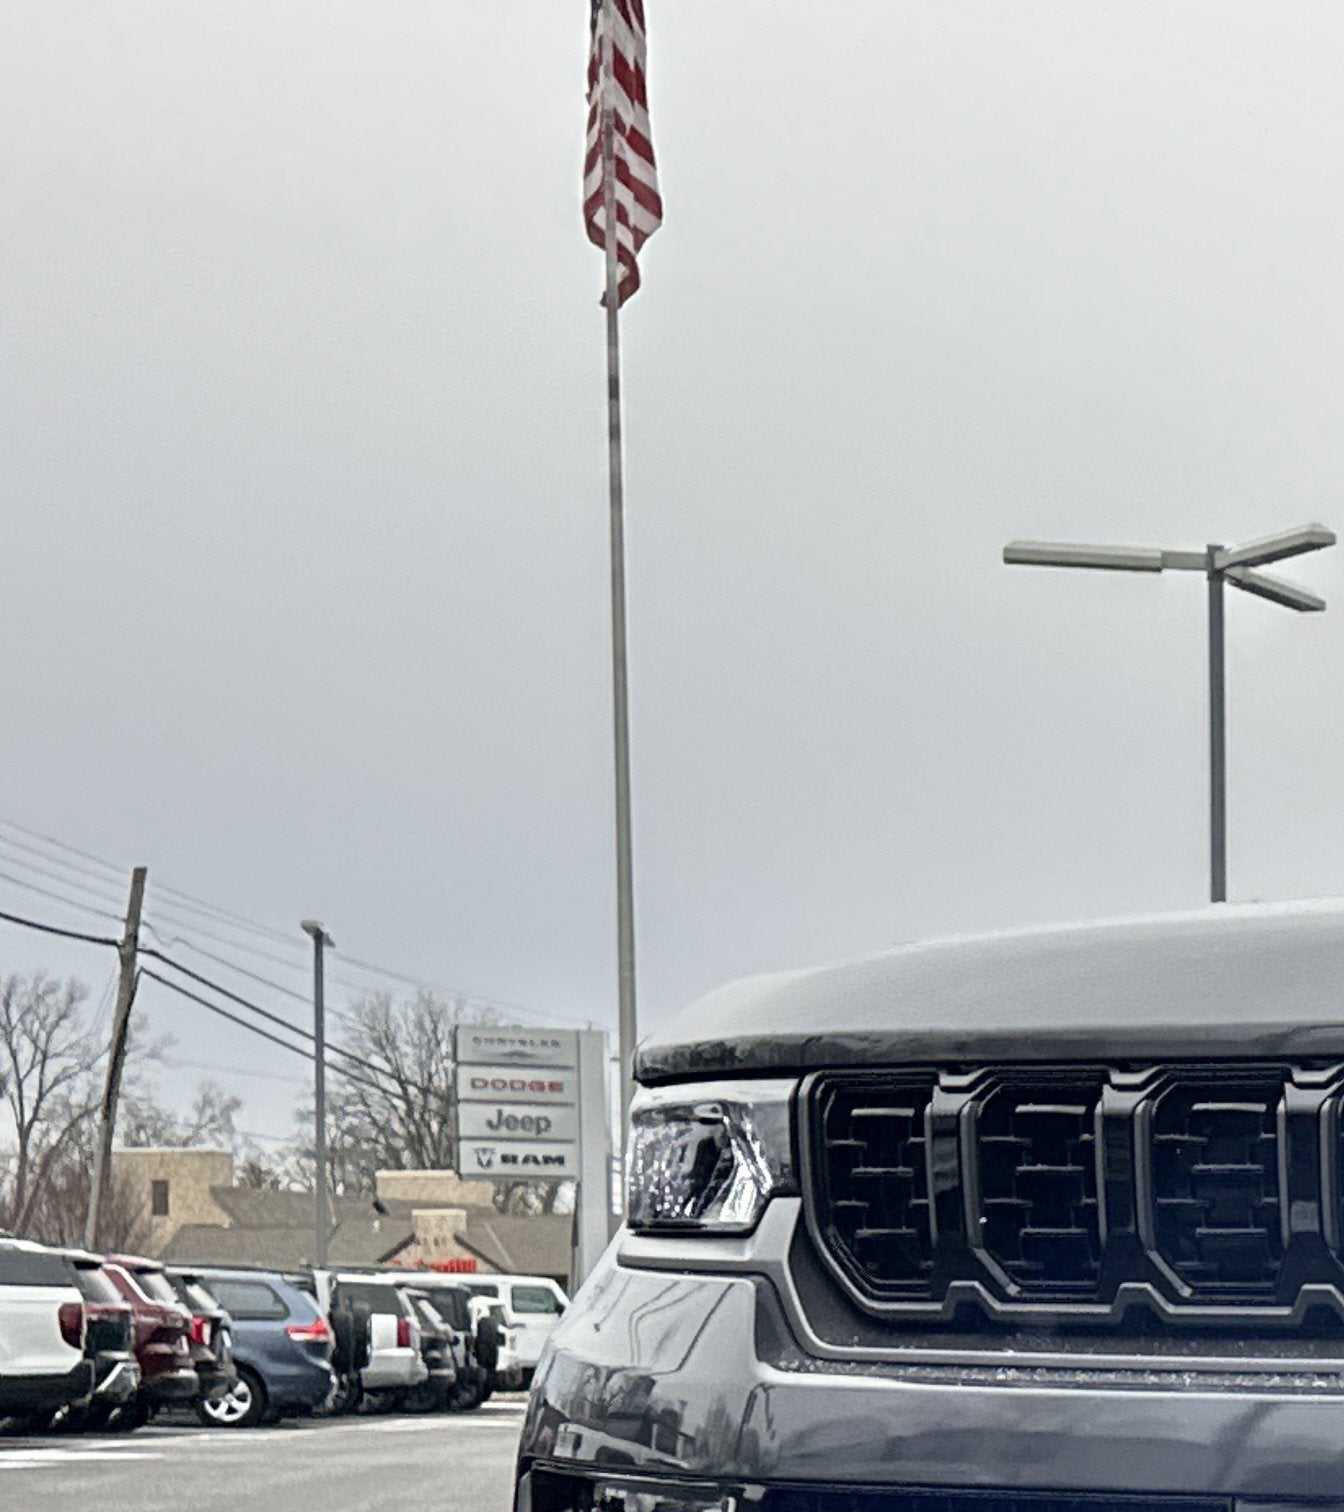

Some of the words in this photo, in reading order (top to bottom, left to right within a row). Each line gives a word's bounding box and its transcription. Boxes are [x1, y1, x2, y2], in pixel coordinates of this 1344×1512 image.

[470, 1077, 564, 1092] DODGE
[486, 1109, 551, 1135] Jeep
[501, 1154, 565, 1166] RAM
